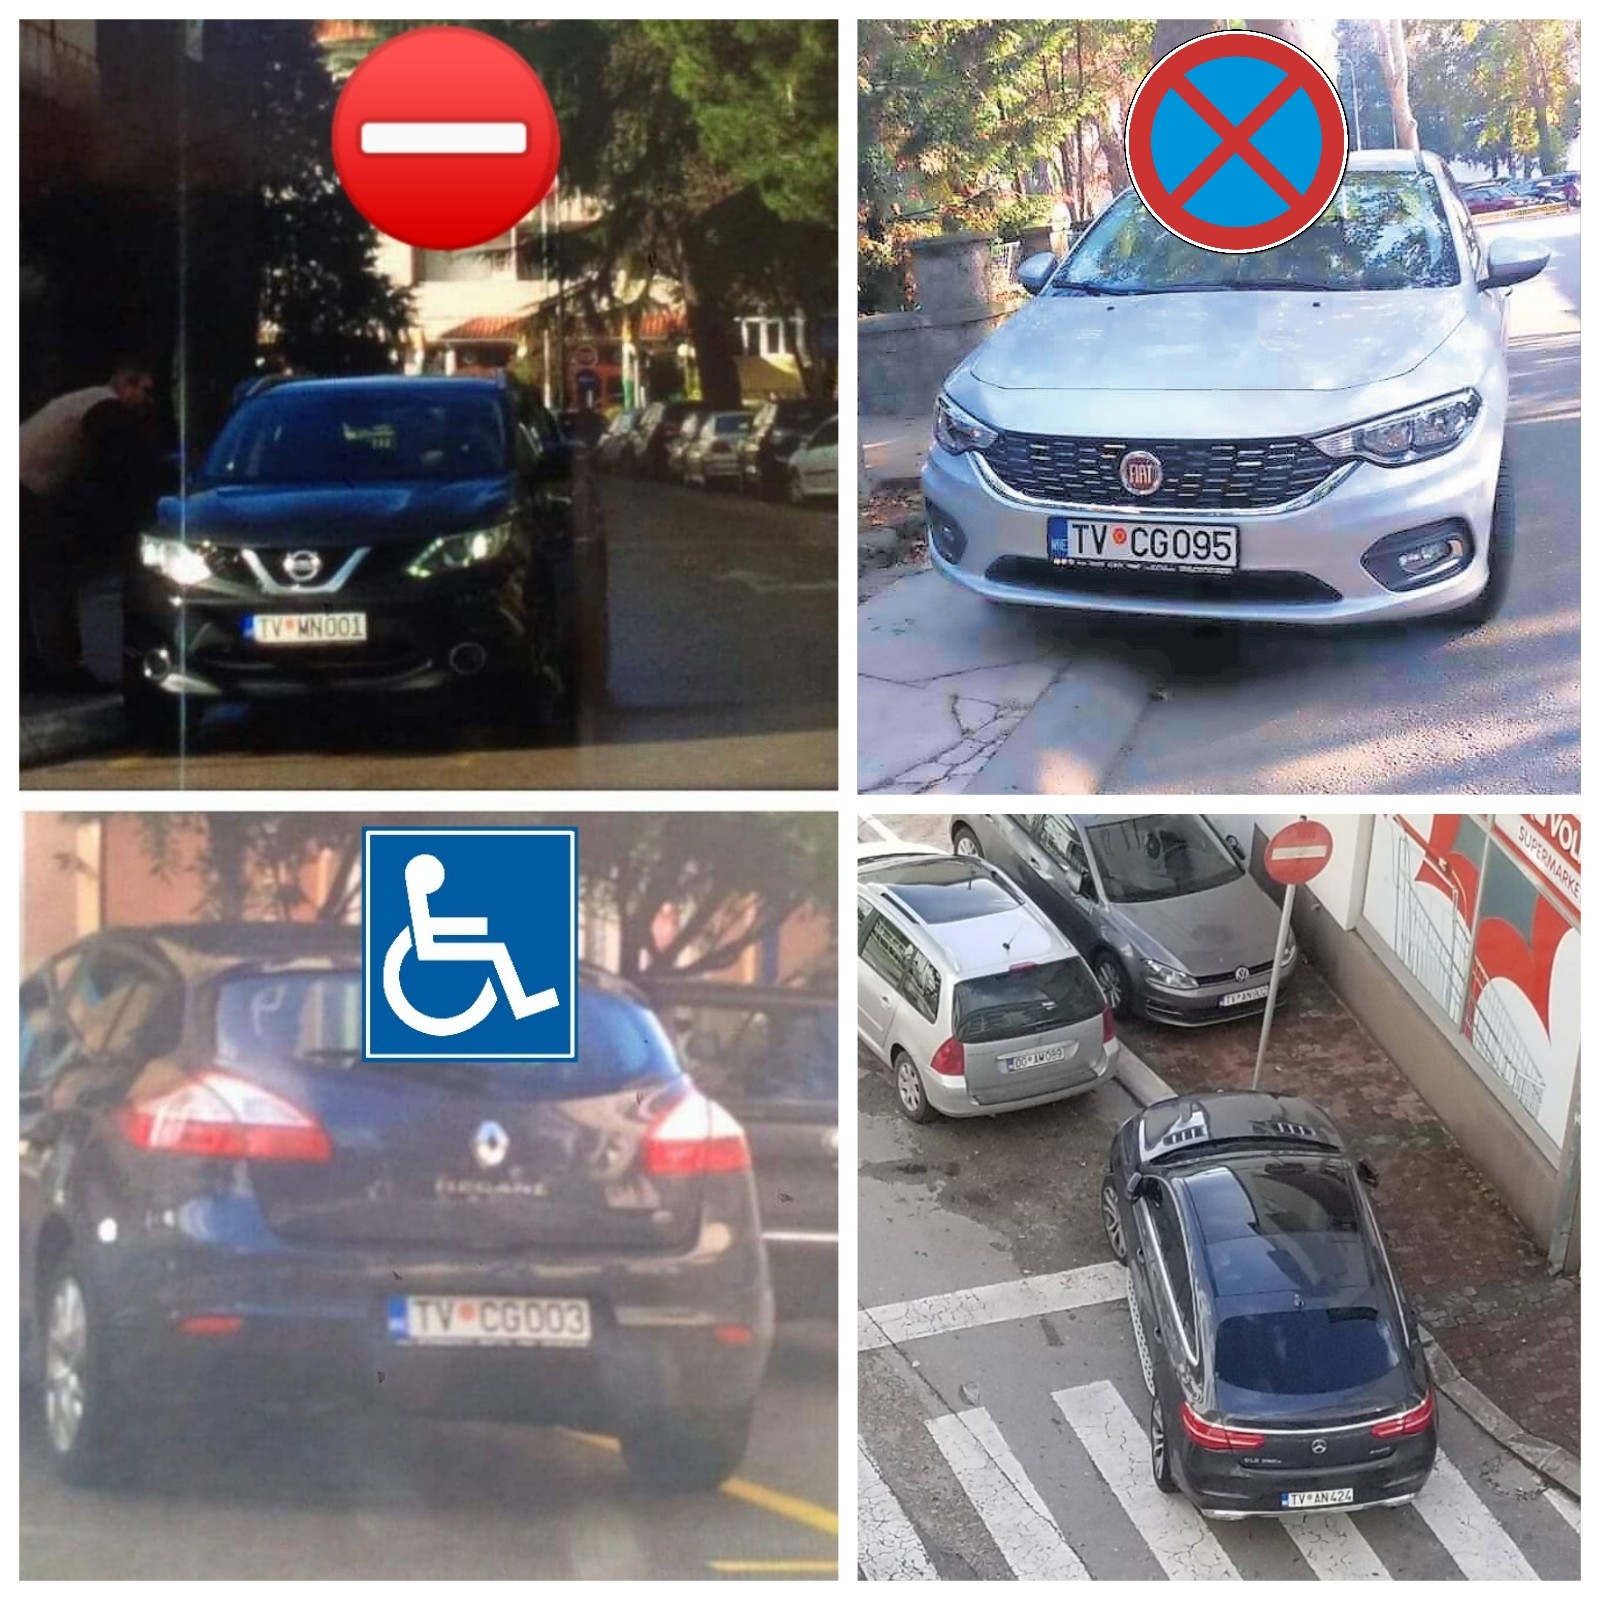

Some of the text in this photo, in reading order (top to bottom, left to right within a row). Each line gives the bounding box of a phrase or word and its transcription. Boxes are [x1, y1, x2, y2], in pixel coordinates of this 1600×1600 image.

[1129, 463, 1153, 485] FIAT
[1071, 523, 1232, 561] TV CG095
[261, 618, 281, 638] TV
[416, 1300, 584, 1335] TV CG003
[1291, 1490, 1353, 1506] TV AN424
